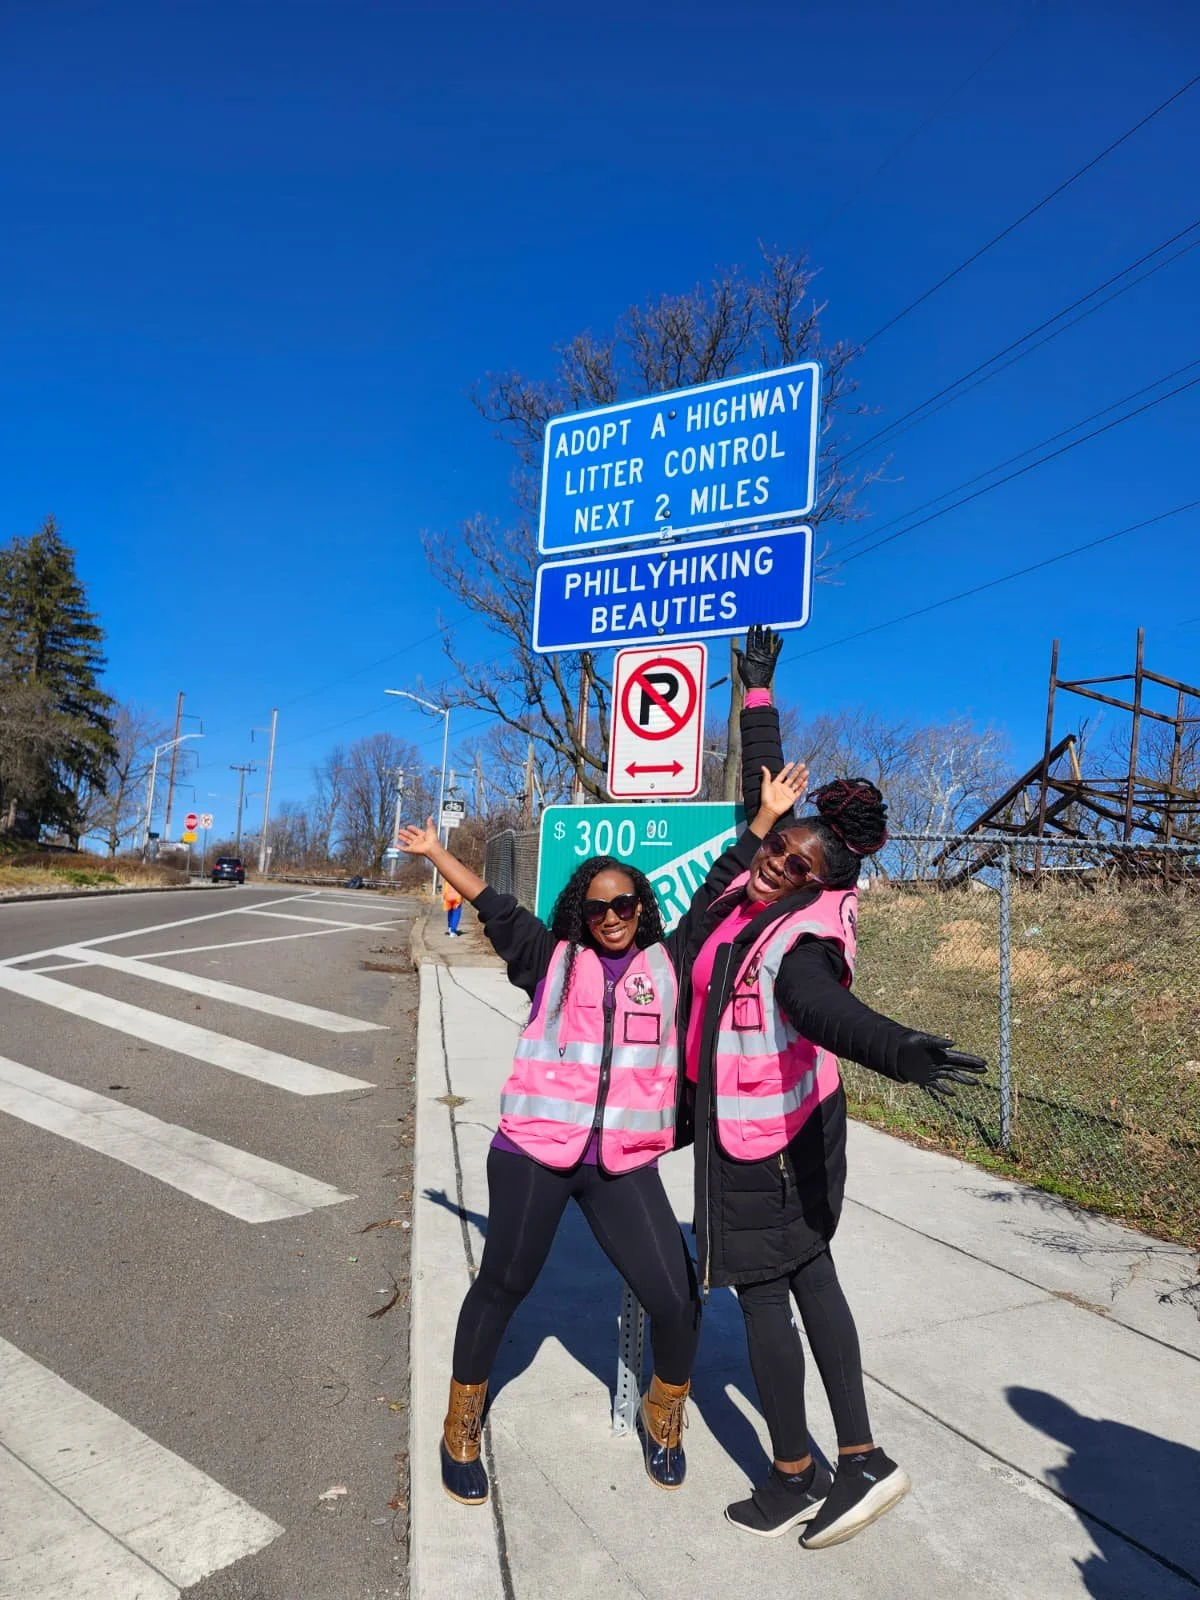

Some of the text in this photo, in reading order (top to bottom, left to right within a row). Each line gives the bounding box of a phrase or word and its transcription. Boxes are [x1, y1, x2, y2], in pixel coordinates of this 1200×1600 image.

[555, 381, 804, 458] ADOPT A HIGHWAY
[565, 431, 785, 495] LITTER CONTROL
[574, 476, 769, 534] NEXT 2 MILES
[564, 546, 773, 599] PHILLYHIKING
[591, 591, 737, 633] BEAUTIES
[639, 673, 679, 725] P
[574, 819, 635, 856] 300
